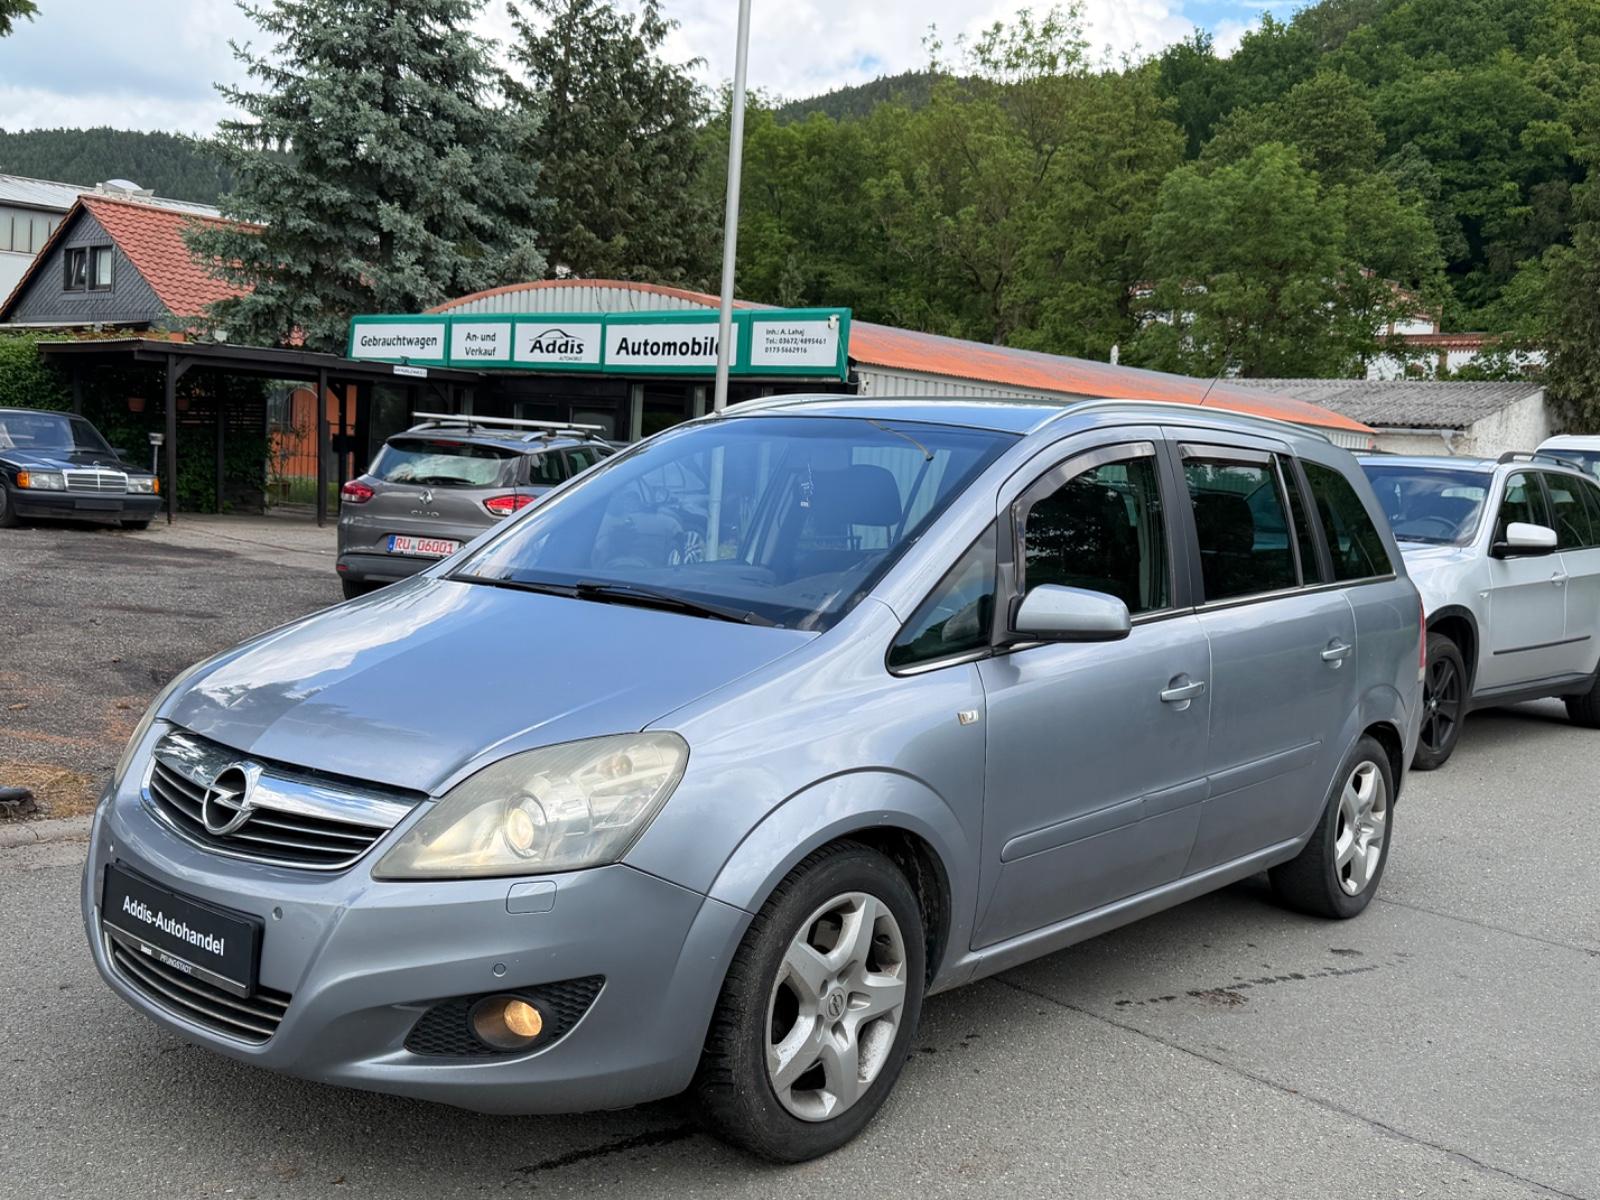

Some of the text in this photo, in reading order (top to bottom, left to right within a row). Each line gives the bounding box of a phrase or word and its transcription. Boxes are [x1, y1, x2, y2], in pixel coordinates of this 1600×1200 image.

[360, 335, 438, 349] Gebrauchtwagen
[465, 332, 496, 342] An- und
[465, 346, 496, 357] Verkauf
[529, 338, 584, 354] Addis
[396, 537, 453, 554] RU 06001
[122, 895, 225, 957] Addis-Autohandel
